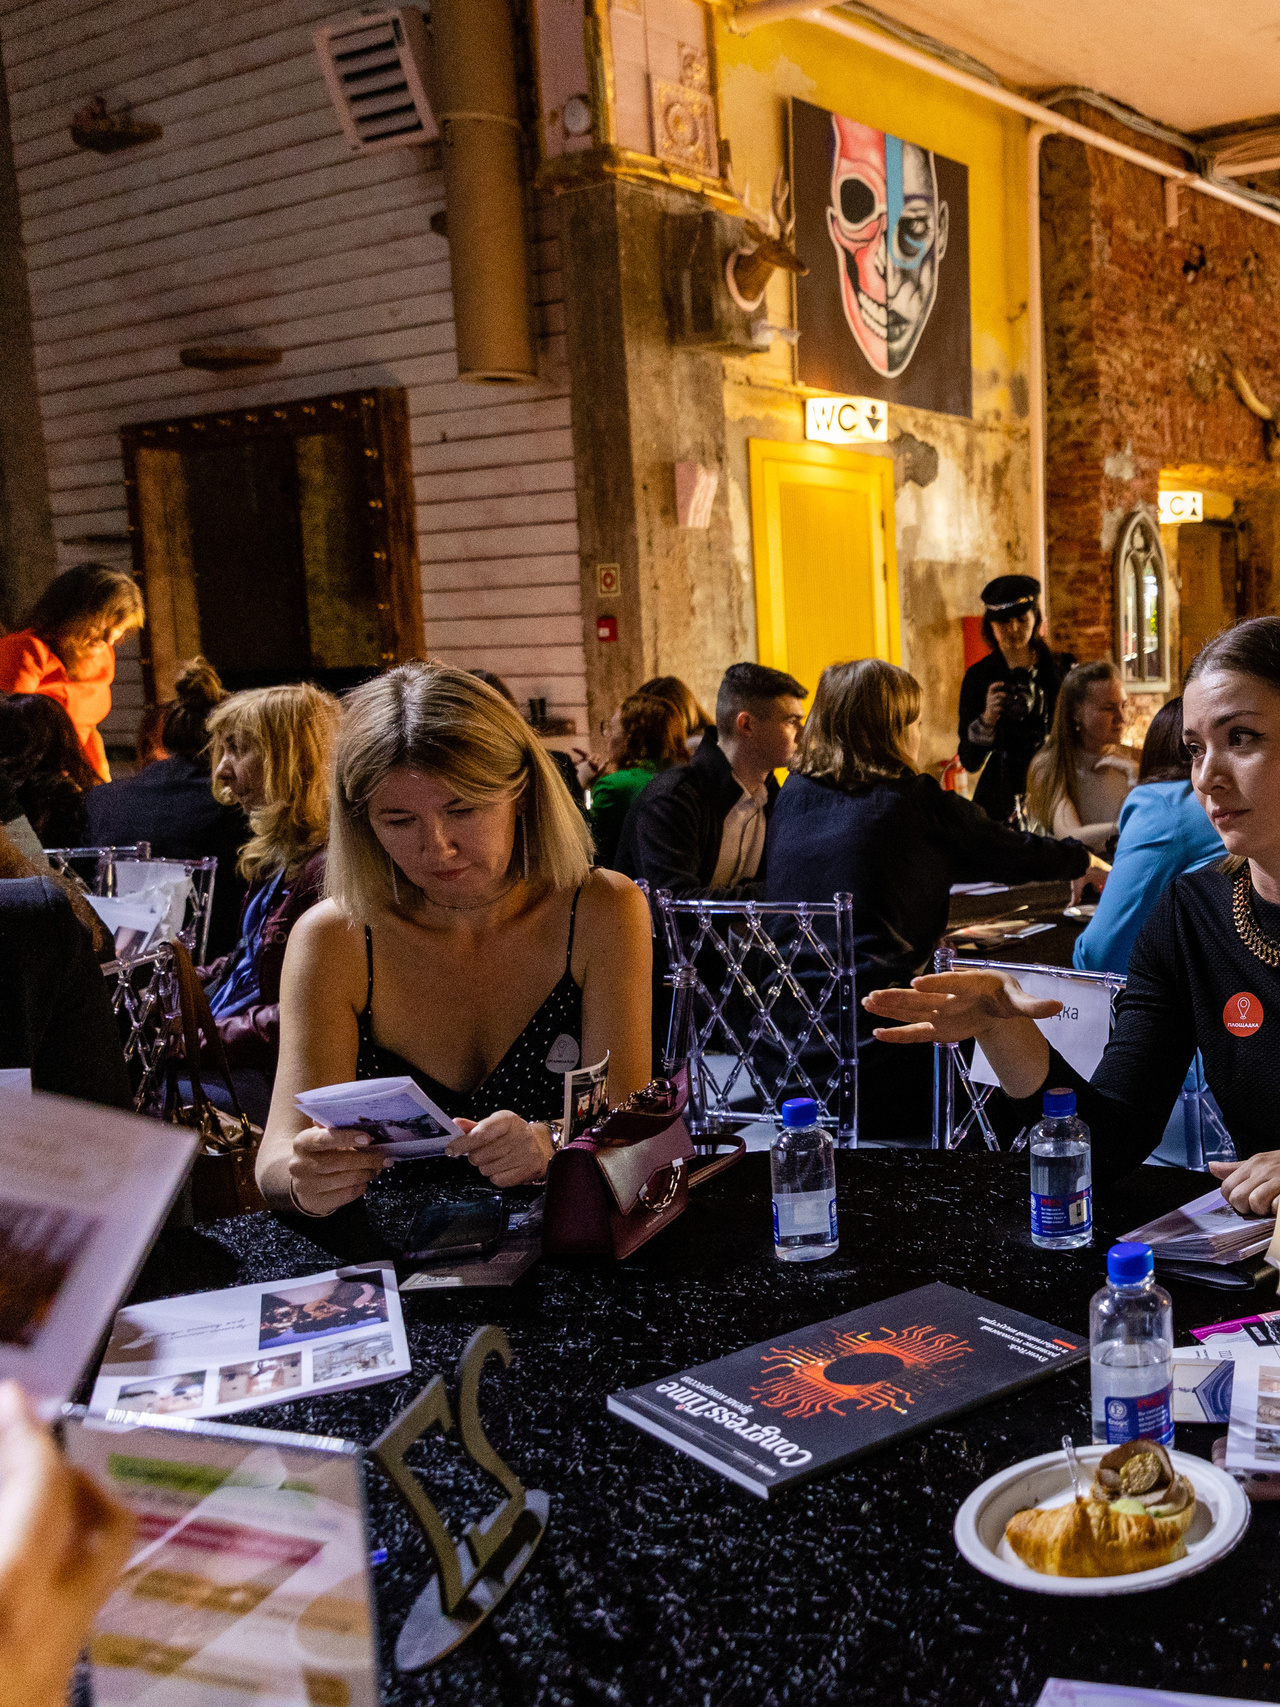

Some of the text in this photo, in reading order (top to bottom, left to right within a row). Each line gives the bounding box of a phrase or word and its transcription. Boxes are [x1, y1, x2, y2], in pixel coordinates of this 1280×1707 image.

[812, 404, 857, 431] WC
[977, 1316, 1018, 1334] индустрии
[980, 1325, 1061, 1358] развитие технологий
[1015, 1331, 1063, 1351] событийной
[680, 1375, 754, 1415] Время конгрессов
[655, 1381, 813, 1467] CongressTime
